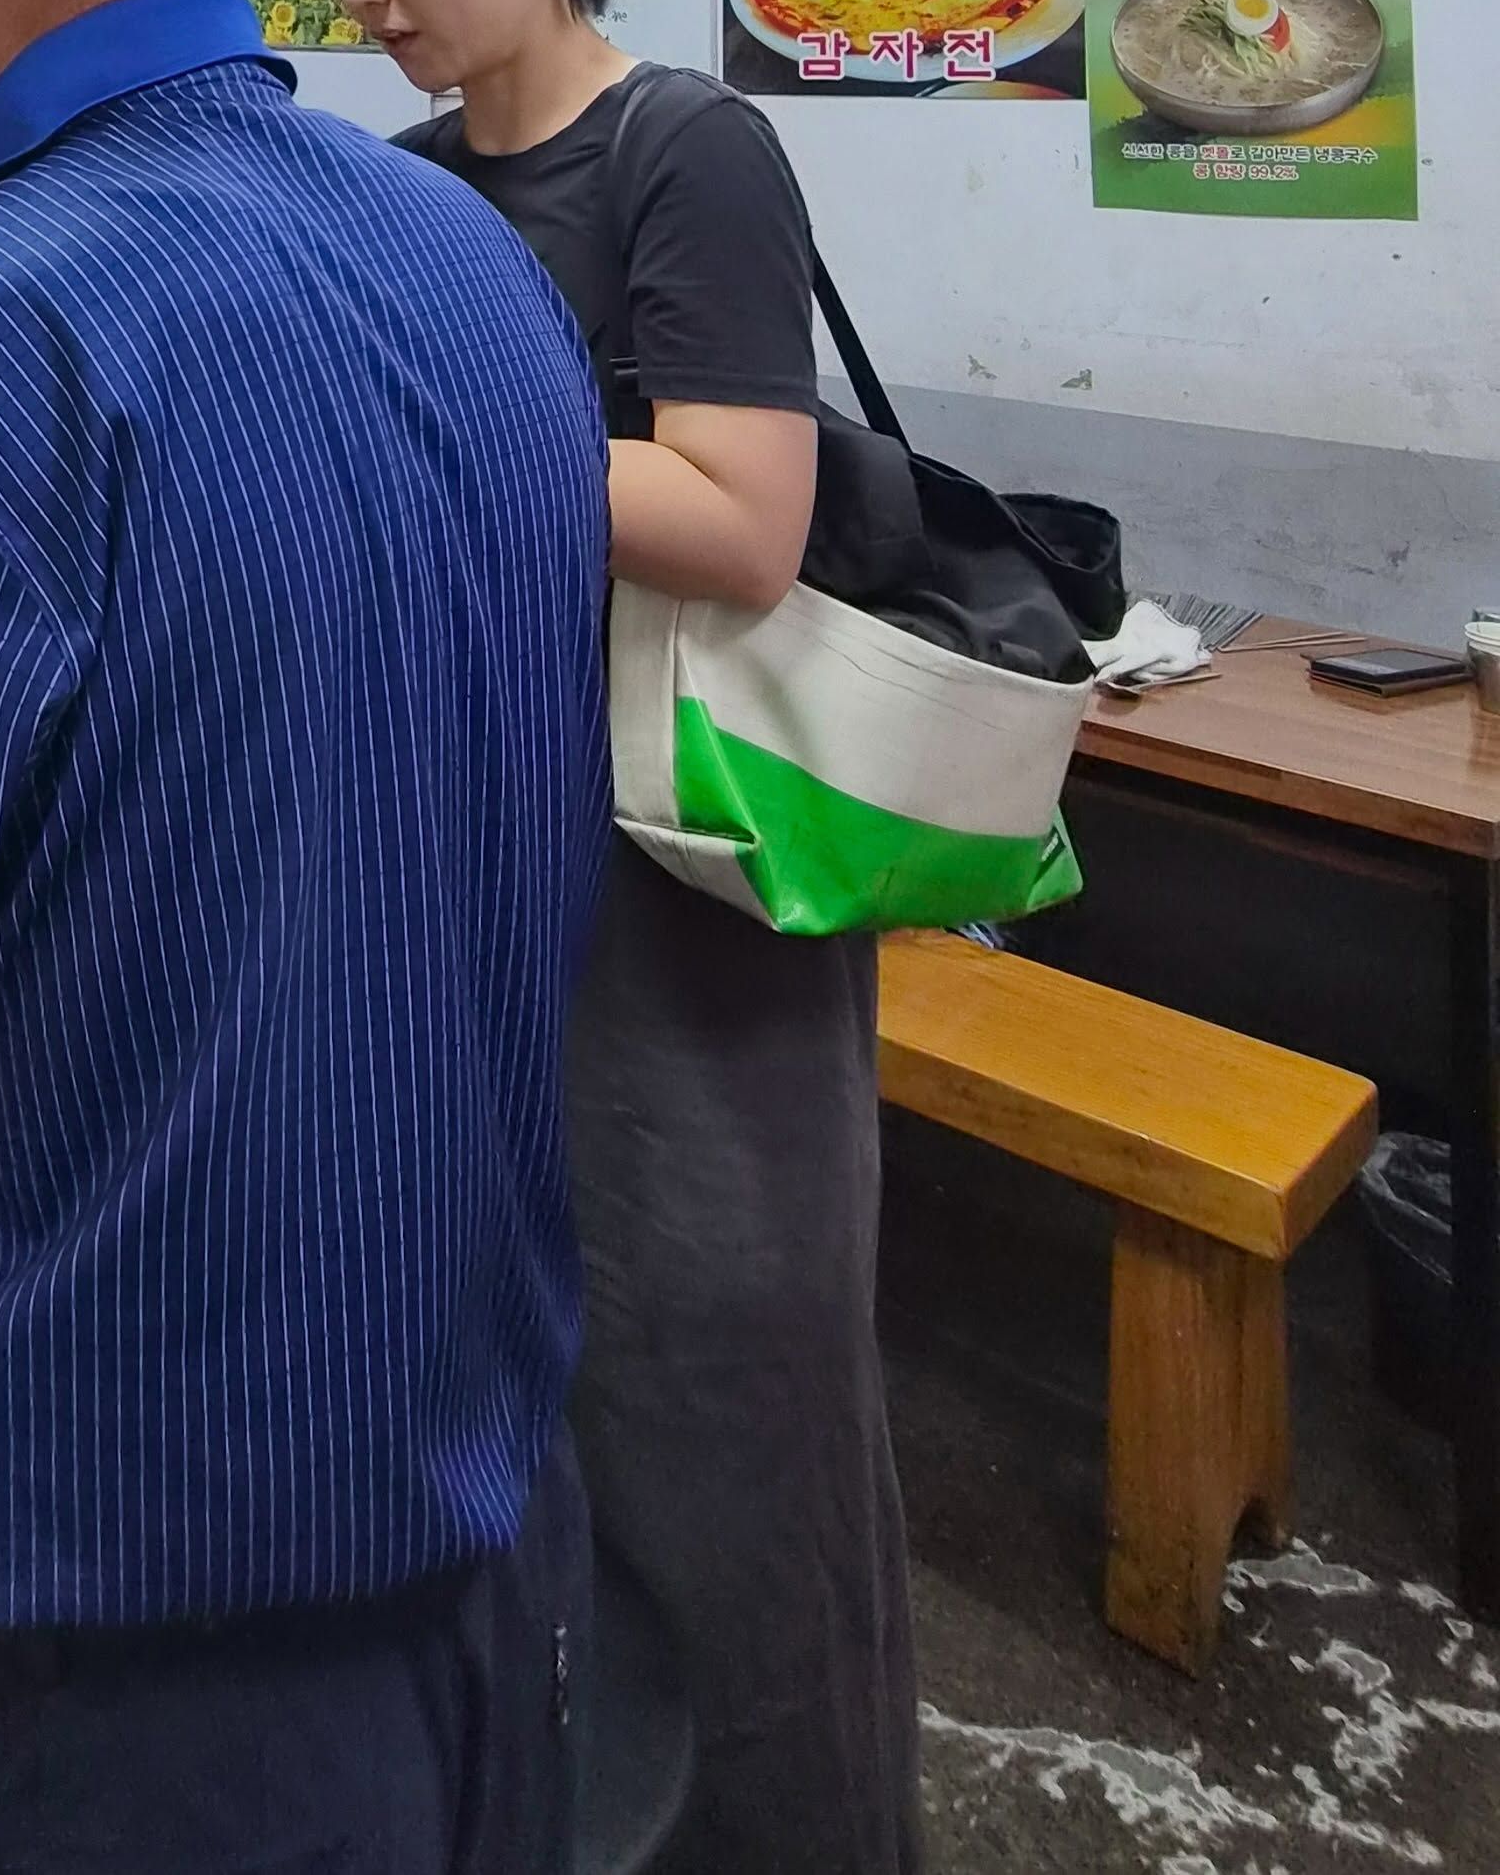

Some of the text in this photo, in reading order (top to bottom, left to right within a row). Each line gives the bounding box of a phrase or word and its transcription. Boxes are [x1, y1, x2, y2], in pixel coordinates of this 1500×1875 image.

[1121, 143, 1165, 160] 신선한
[1314, 146, 1379, 164] 냉콩국수
[1249, 164, 1299, 180] 99.2%
